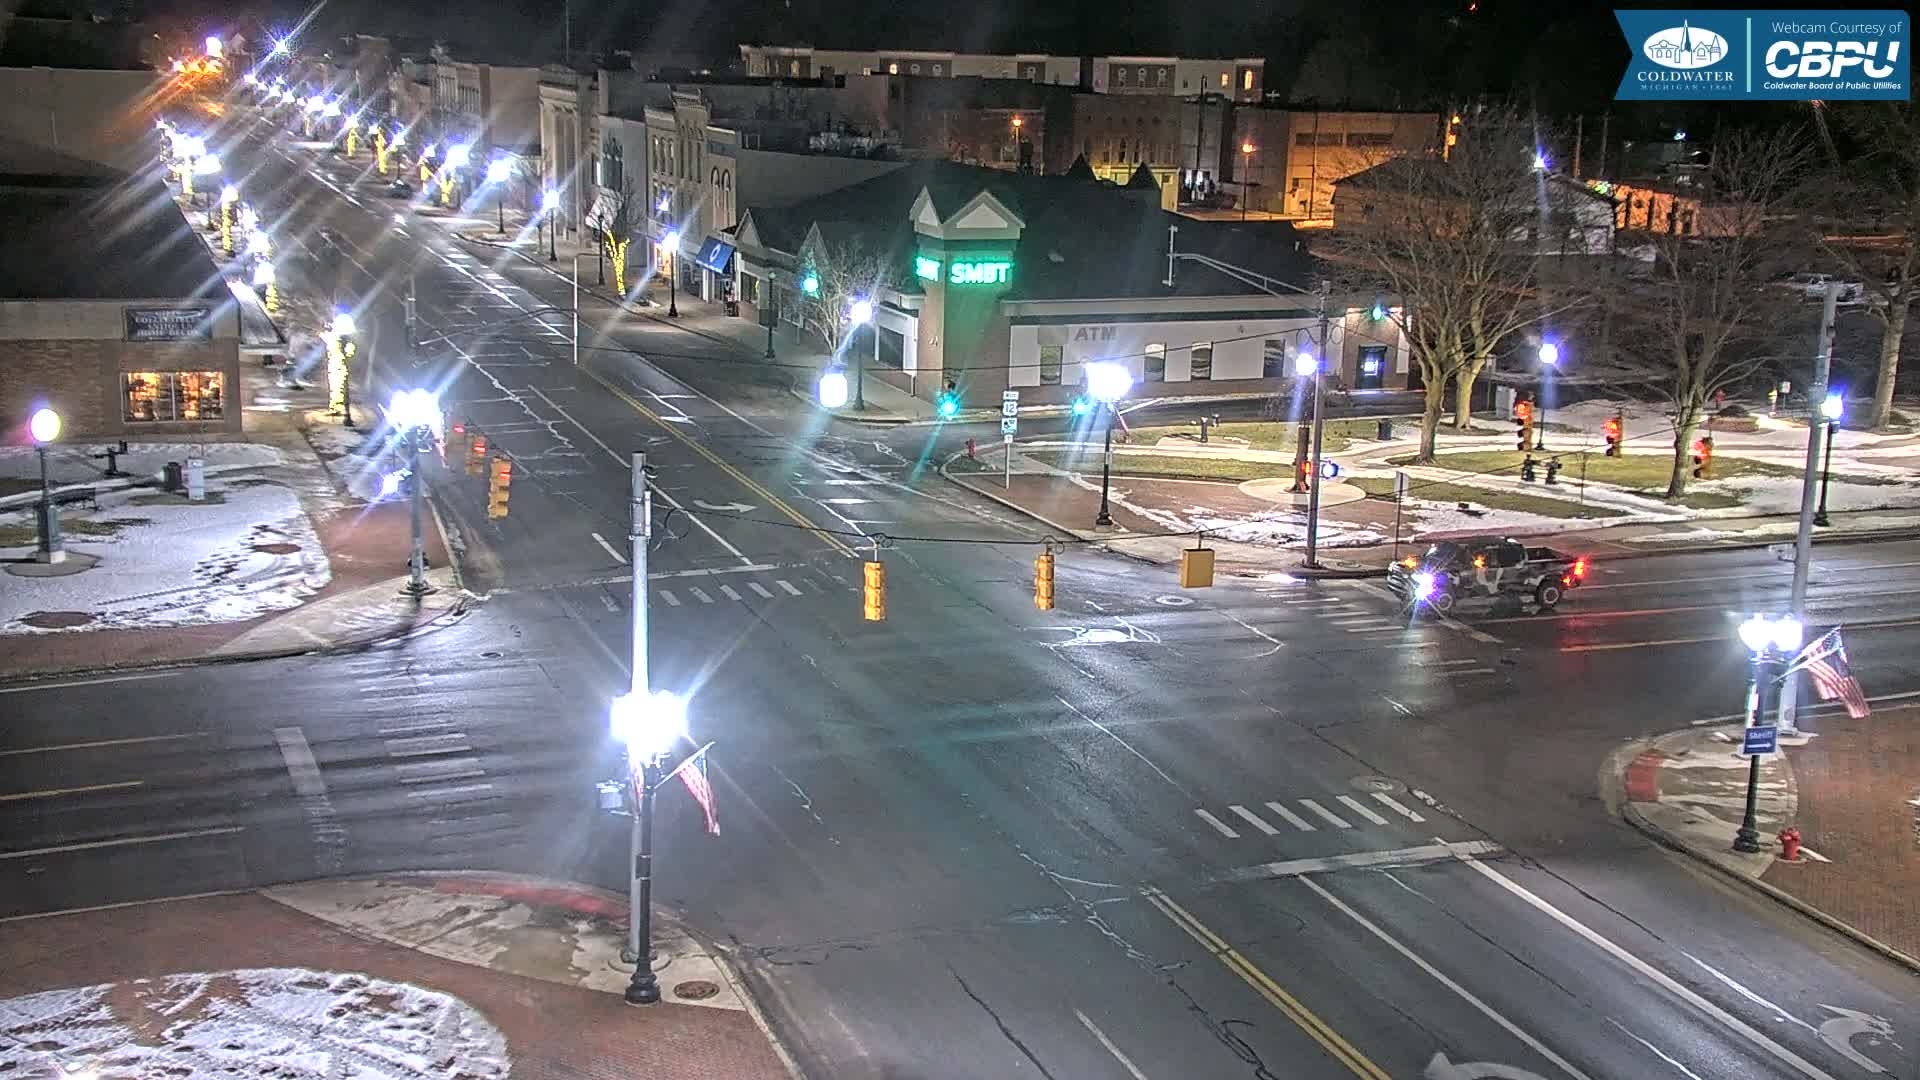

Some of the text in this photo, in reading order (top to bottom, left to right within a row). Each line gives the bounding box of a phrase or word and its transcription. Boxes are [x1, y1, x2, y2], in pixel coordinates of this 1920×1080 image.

[950, 261, 1010, 284] SMBT
[1073, 326, 1117, 341] ATM
[1005, 403, 1015, 413] 12
